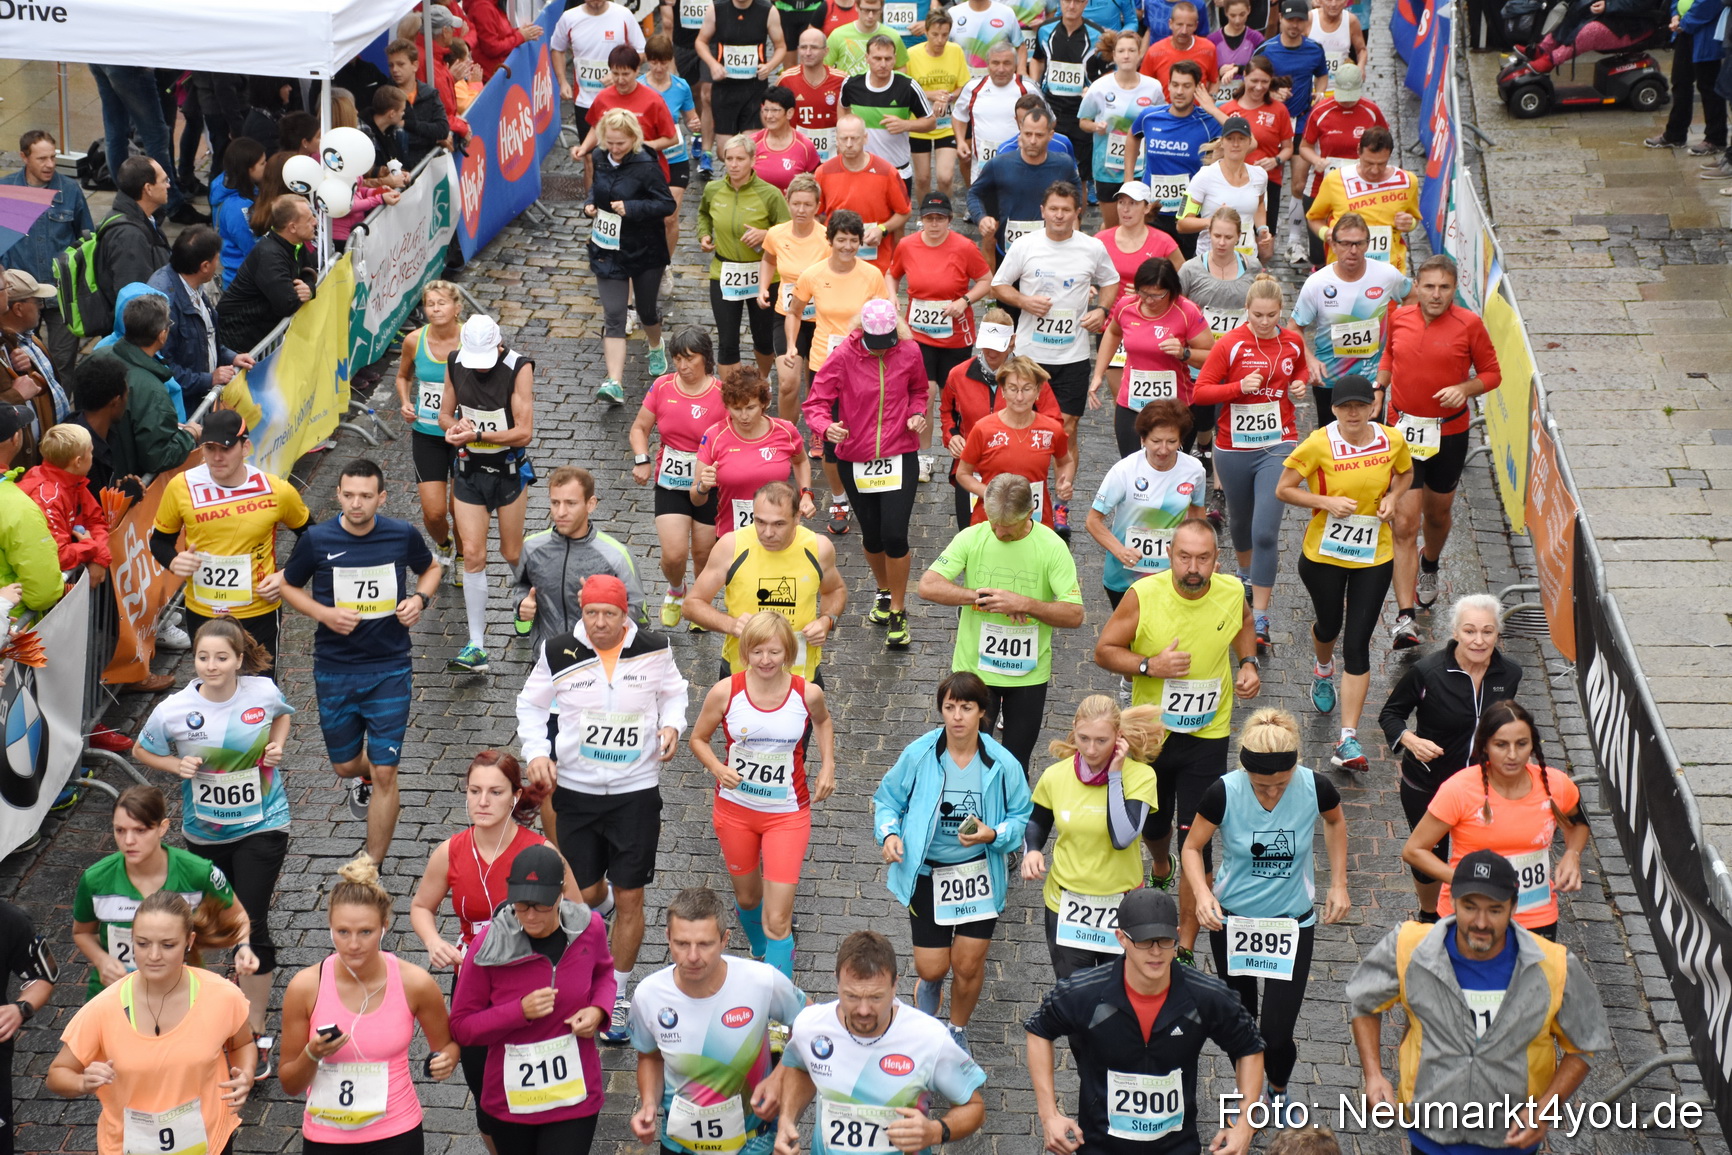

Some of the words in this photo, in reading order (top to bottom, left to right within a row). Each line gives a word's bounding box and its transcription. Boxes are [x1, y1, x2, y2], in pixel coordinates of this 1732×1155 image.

[887, 11, 914, 23] 2489
[727, 54, 754, 66] 2647
[580, 66, 609, 80] 2703
[1051, 69, 1081, 84] 2036
[499, 102, 534, 165] Hervis
[1149, 138, 1189, 152] SYSCAD
[1155, 183, 1187, 199] 2395
[1348, 197, 1377, 211] MAX
[1381, 191, 1408, 204] BÖGL
[725, 271, 759, 286] 2215
[734, 288, 749, 296] Petra
[913, 308, 948, 325] 2322
[1211, 316, 1240, 331] 217
[1036, 317, 1073, 334] 2742
[1043, 335, 1064, 345] Hubert
[1342, 330, 1372, 346] 254
[1346, 347, 1370, 355] Werner
[1133, 380, 1173, 397] 2255
[1236, 412, 1277, 431] 2256
[863, 459, 893, 476] 225
[1333, 461, 1360, 472] MAX
[1363, 455, 1391, 468] BÖGL
[869, 478, 886, 487] Petra
[195, 508, 231, 524] MAX
[236, 498, 278, 515] BÖGL
[1329, 522, 1374, 545] 2741
[1336, 545, 1361, 556] Margit
[1143, 559, 1159, 567] Liba
[203, 567, 239, 587] 322
[213, 590, 227, 599] Jiri
[354, 580, 379, 599] 75
[356, 604, 377, 612] Mate
[985, 635, 1031, 657] 2401
[992, 658, 1023, 669] Michael
[1167, 691, 1217, 713] 2717
[1176, 714, 1206, 726] Josef
[585, 724, 639, 747] 2745
[593, 749, 627, 763] Rüdiger
[735, 756, 786, 786] 2764
[199, 782, 255, 806] 2066
[740, 781, 773, 798] Claudia
[213, 808, 242, 818] Hanna
[1252, 861, 1293, 870] HIRSCH
[940, 874, 990, 903] 2903
[955, 904, 977, 916] Petra
[1065, 900, 1120, 929] 2272
[1075, 929, 1106, 944] Sandra
[1234, 931, 1292, 956] 2895
[1245, 957, 1278, 970] Martina
[725, 1010, 751, 1024] Hervis
[660, 1031, 682, 1039] PARTL
[519, 1055, 568, 1087] 210
[810, 1061, 833, 1073] PARTL
[884, 1058, 911, 1072] Hervis
[338, 1079, 354, 1107] 8
[1115, 1088, 1179, 1115] 2900
[690, 1118, 724, 1139] 15
[1131, 1119, 1164, 1132] Stefan
[159, 1127, 175, 1152] 9
[694, 1142, 723, 1151] Franz
